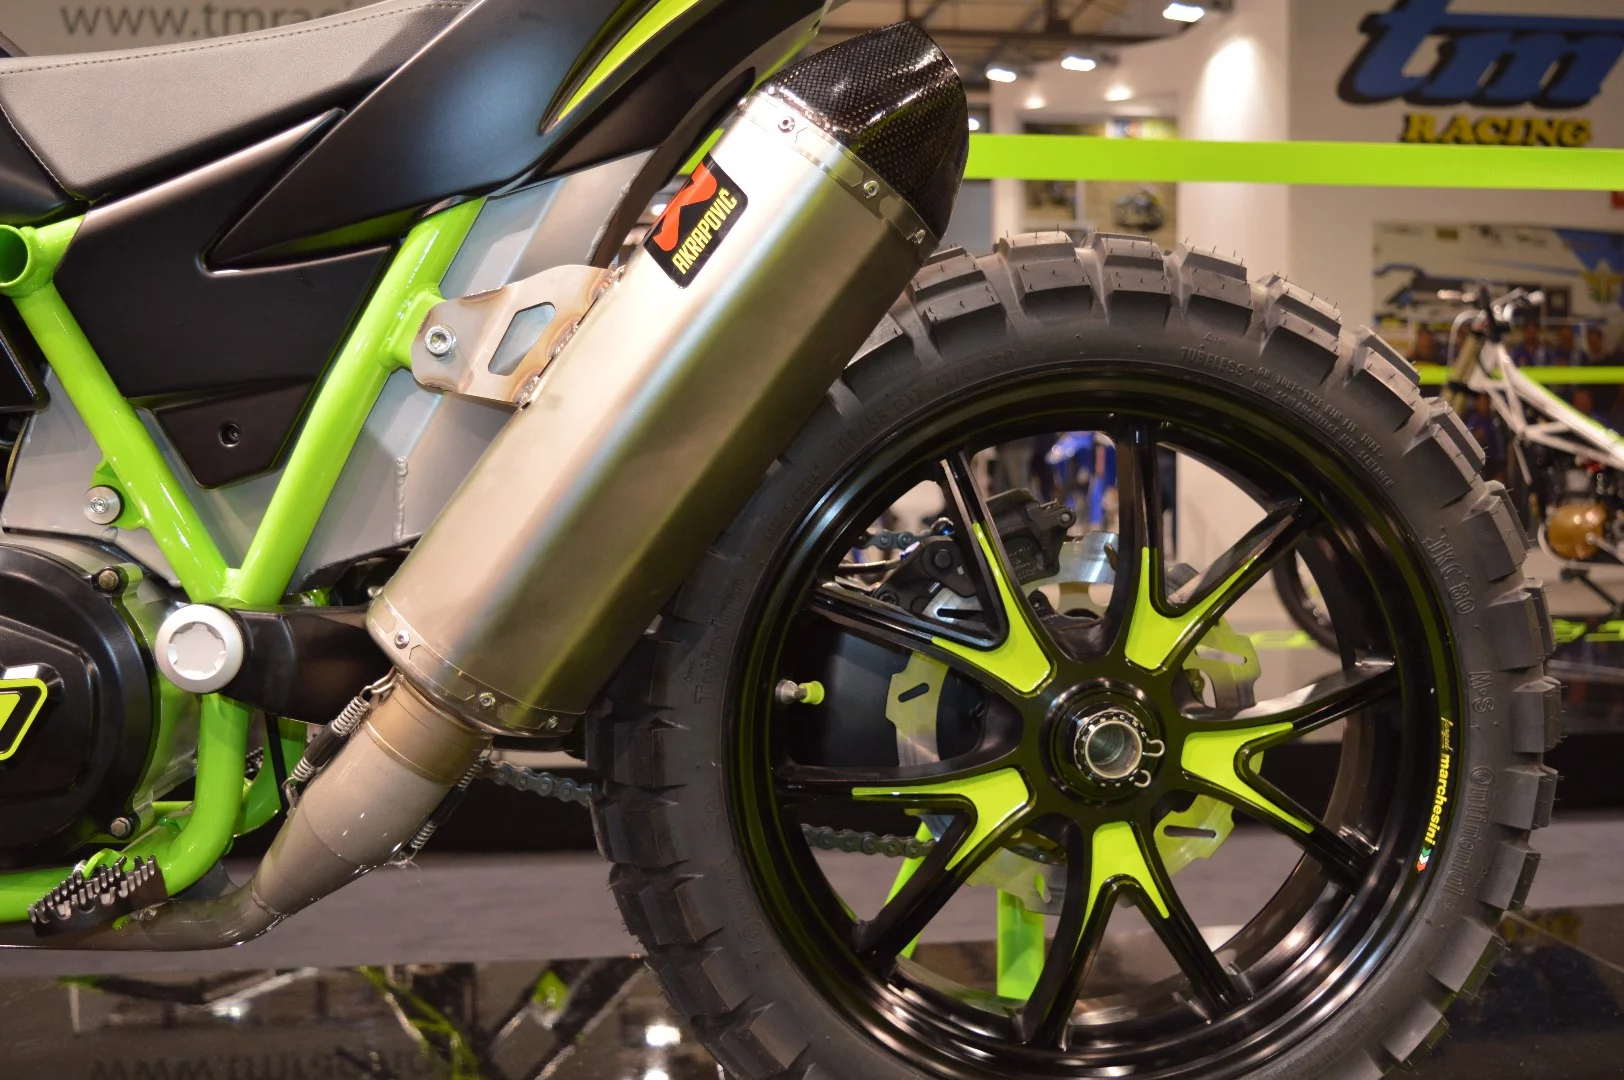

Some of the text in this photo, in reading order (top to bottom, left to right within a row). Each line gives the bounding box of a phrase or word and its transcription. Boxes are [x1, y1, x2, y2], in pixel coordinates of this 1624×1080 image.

[1398, 112, 1592, 147] RACING
[1427, 536, 1477, 617] TKC 80
[1424, 753, 1453, 846] marchesini
